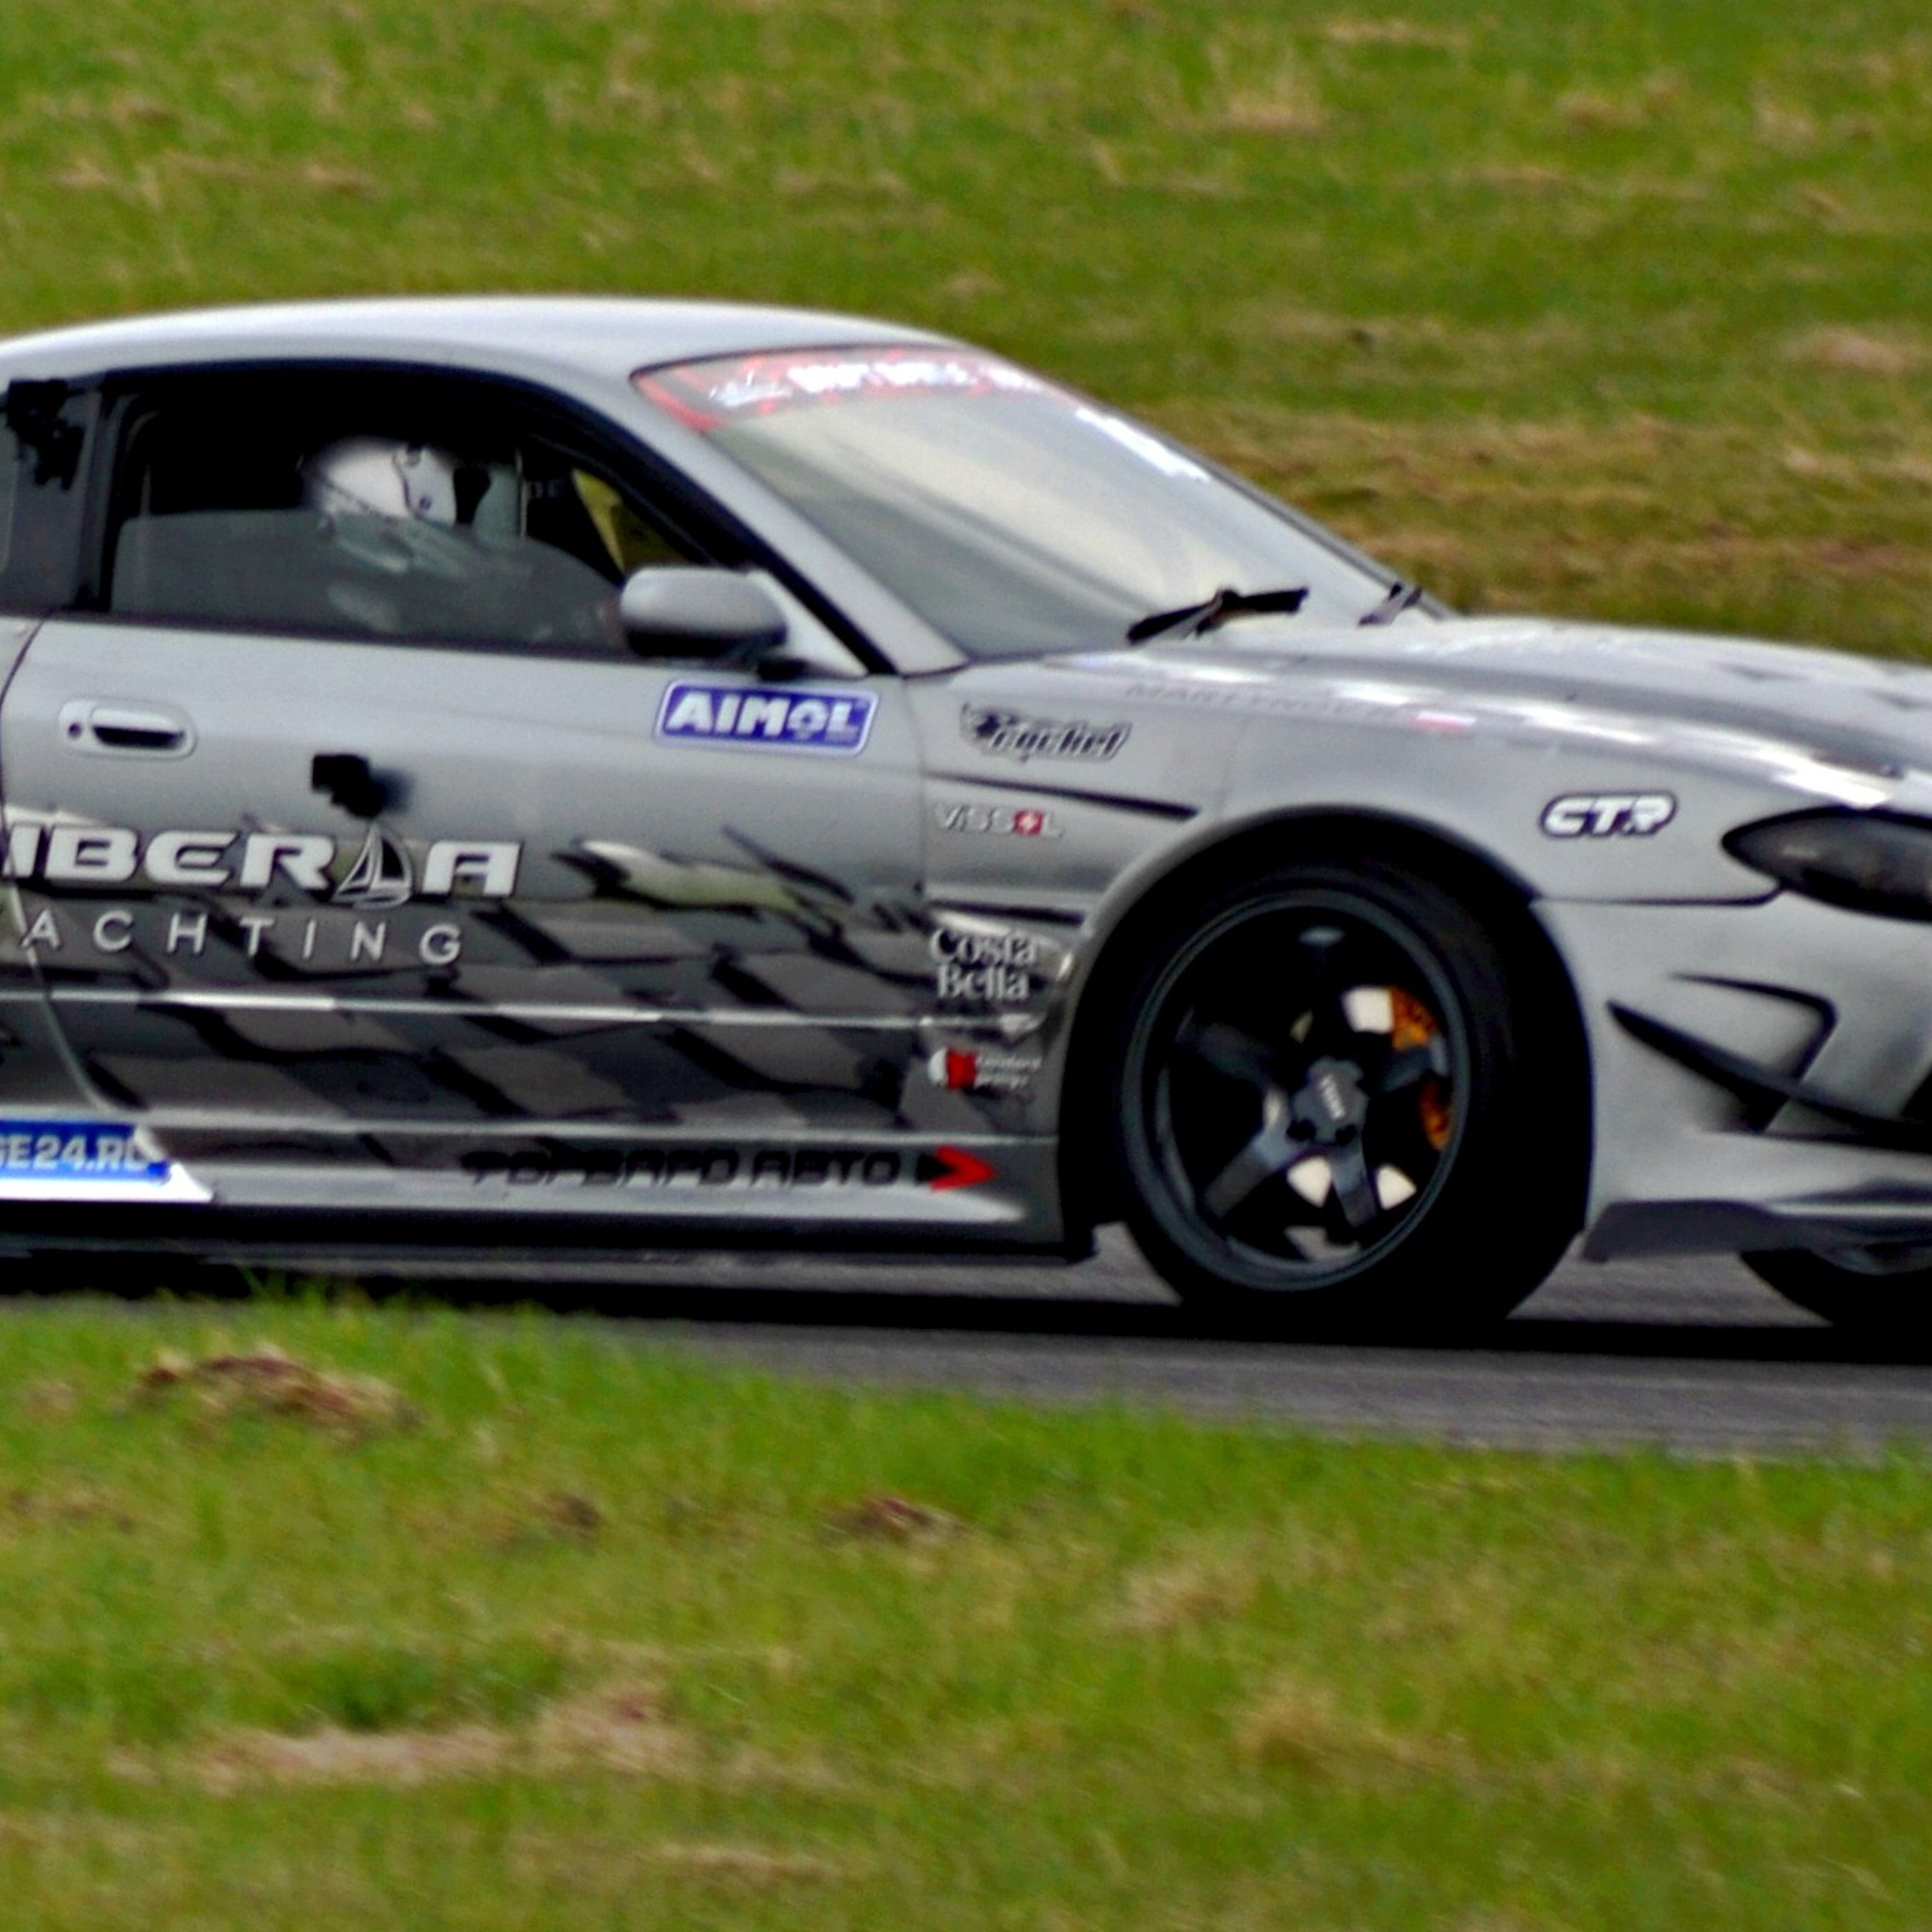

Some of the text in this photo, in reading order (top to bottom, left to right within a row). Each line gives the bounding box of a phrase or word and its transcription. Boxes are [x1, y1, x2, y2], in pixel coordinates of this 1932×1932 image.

[664, 690, 860, 743] AIMOL
[929, 928, 1036, 965] Costa
[937, 963, 1029, 1000] Bella
